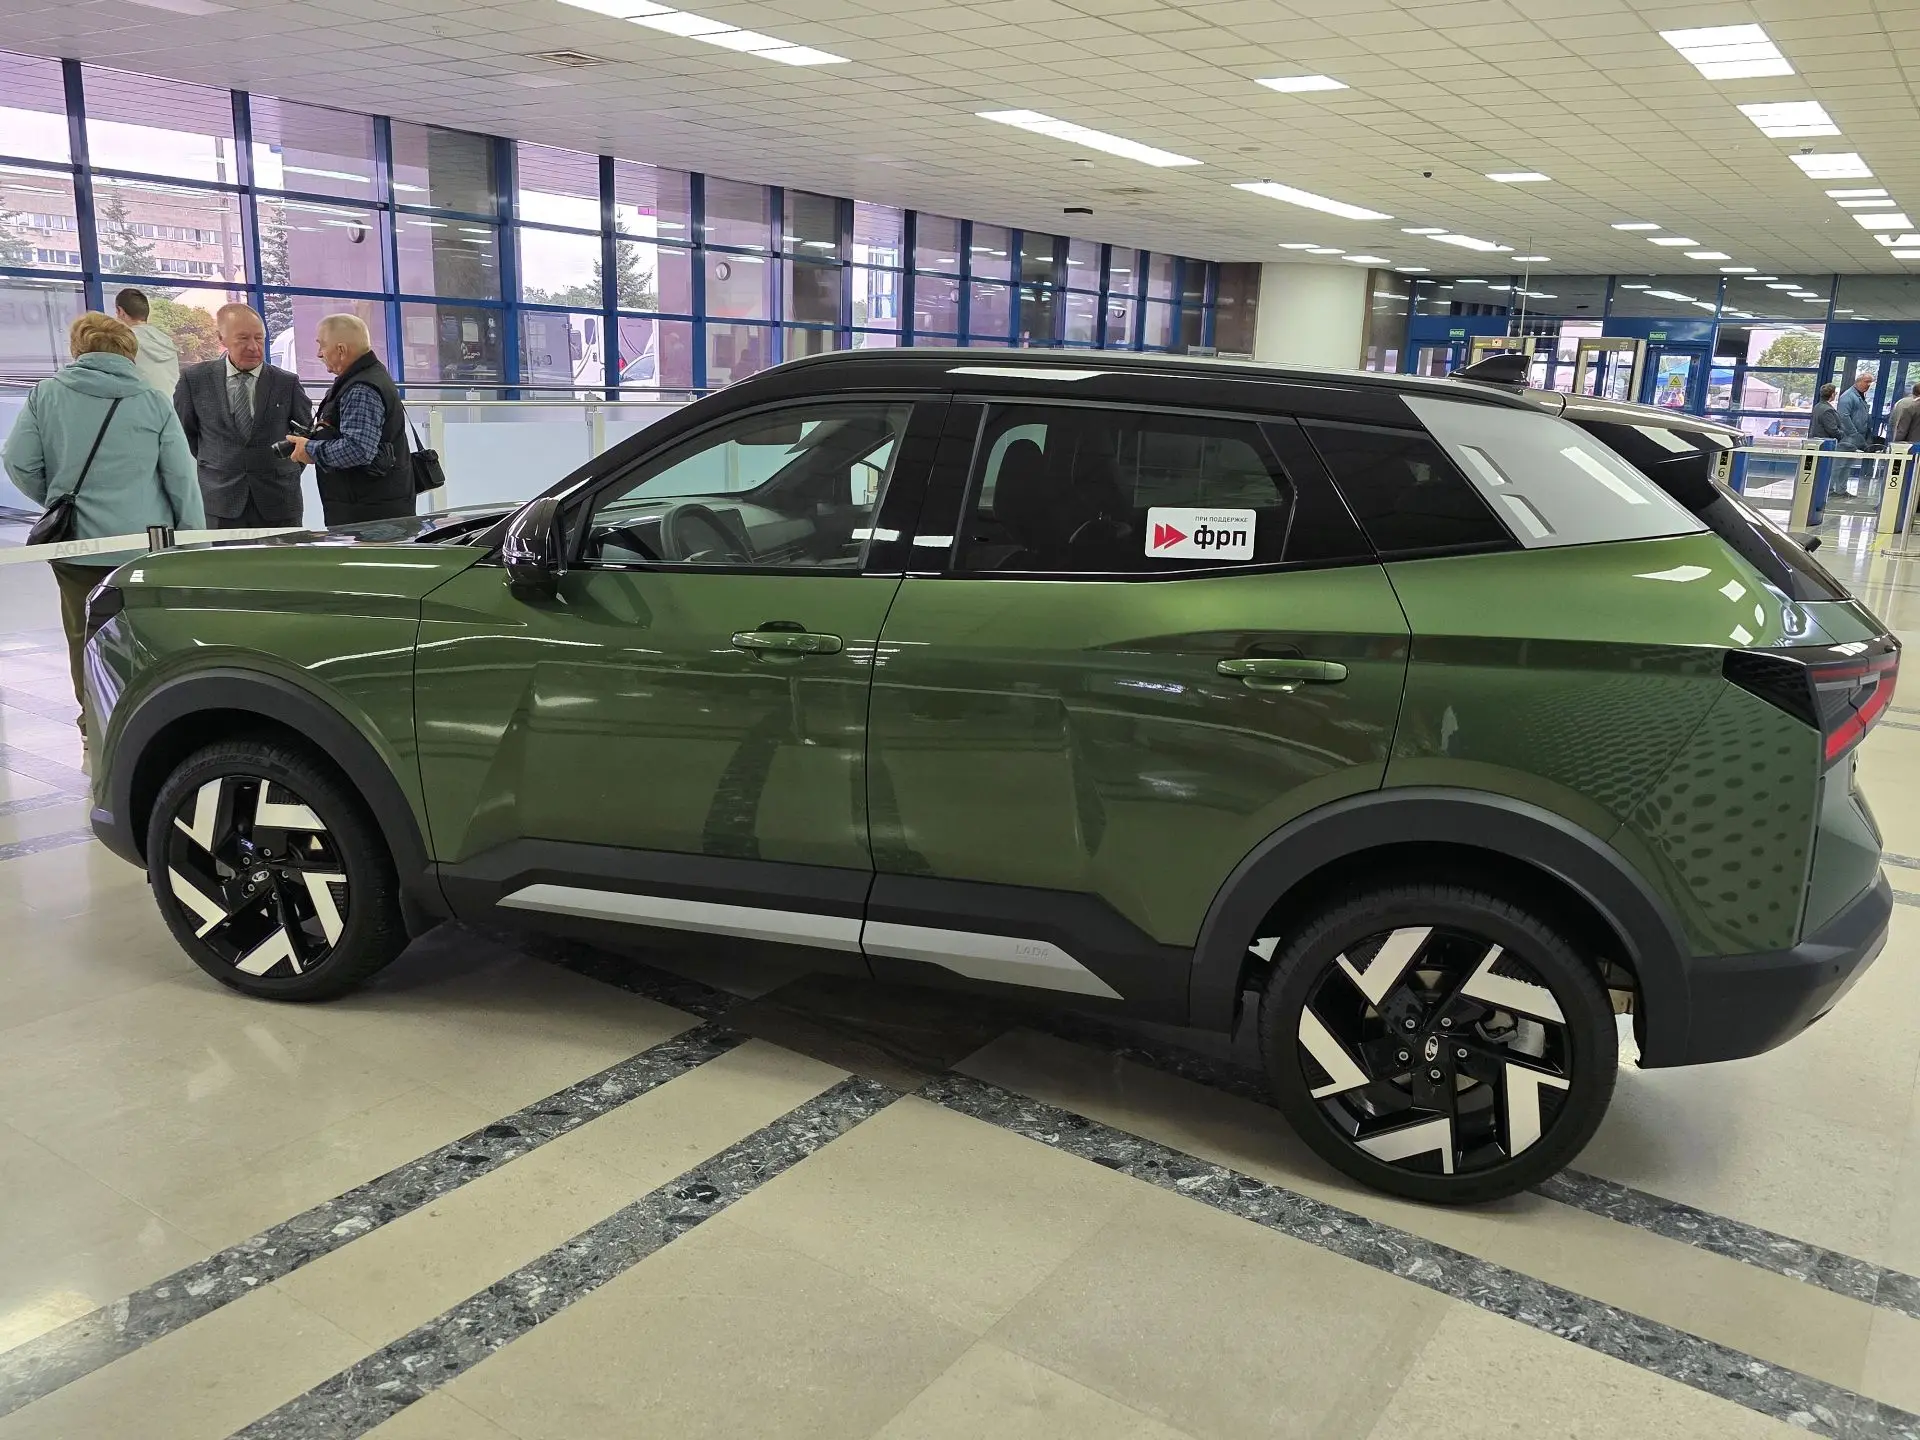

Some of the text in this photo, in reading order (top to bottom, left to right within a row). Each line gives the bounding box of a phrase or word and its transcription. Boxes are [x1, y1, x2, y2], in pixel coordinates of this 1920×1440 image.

[1718, 467, 1726, 477] 6
[1803, 472, 1812, 483] 7
[1889, 477, 1898, 488] 8
[1015, 944, 1049, 959] LADA
